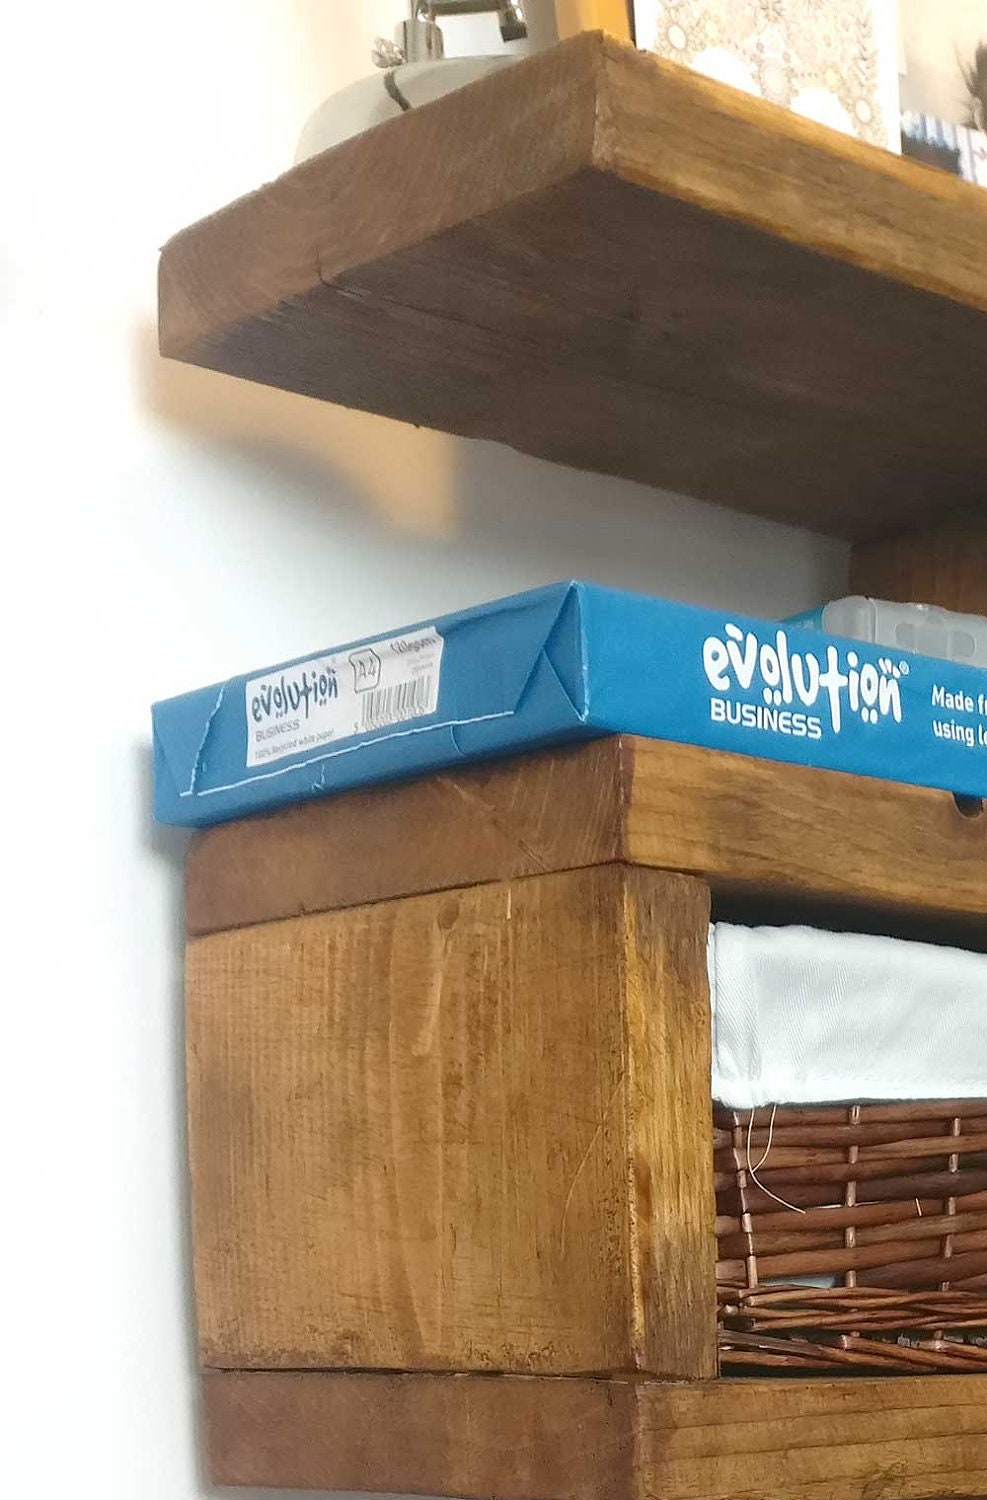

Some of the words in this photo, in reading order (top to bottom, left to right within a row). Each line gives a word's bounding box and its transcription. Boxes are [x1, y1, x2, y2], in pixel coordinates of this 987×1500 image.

[358, 657, 377, 679] A4
[703, 623, 902, 734] evolution
[252, 667, 337, 722] evolution
[932, 684, 974, 712] Made
[255, 719, 300, 742] BUSINESS
[710, 698, 822, 740] BUSINESS
[933, 719, 974, 747] using
